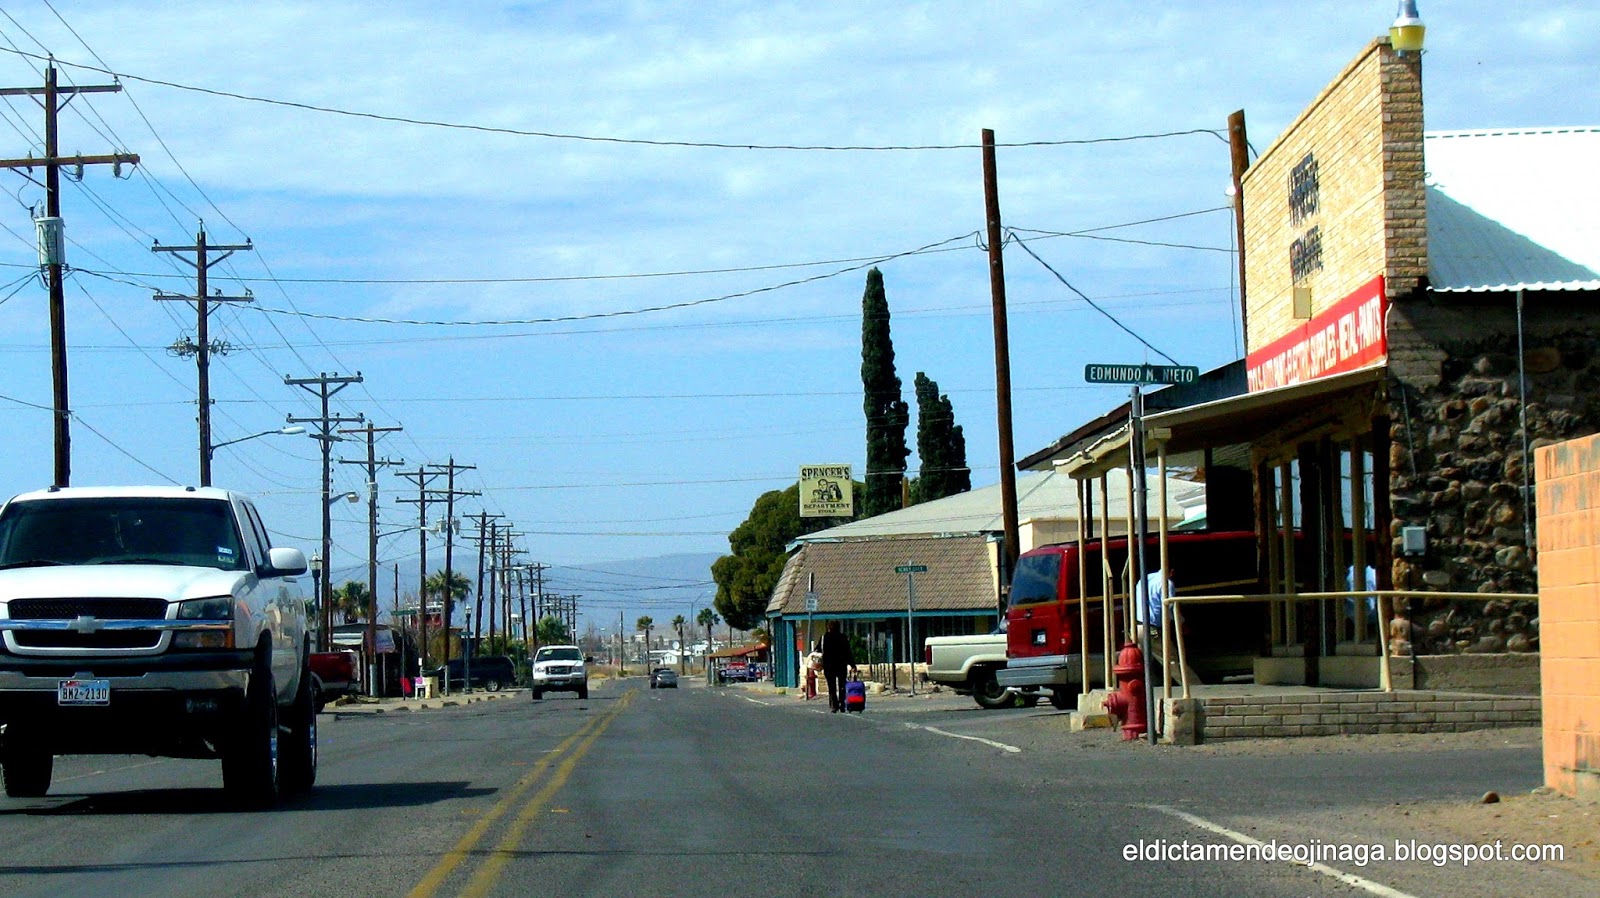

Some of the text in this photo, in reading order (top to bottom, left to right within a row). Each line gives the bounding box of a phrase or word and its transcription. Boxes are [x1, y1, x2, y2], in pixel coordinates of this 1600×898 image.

[1090, 366, 1193, 383] EDMUNDO M. NIETO
[801, 467, 850, 481] SPENCER'S
